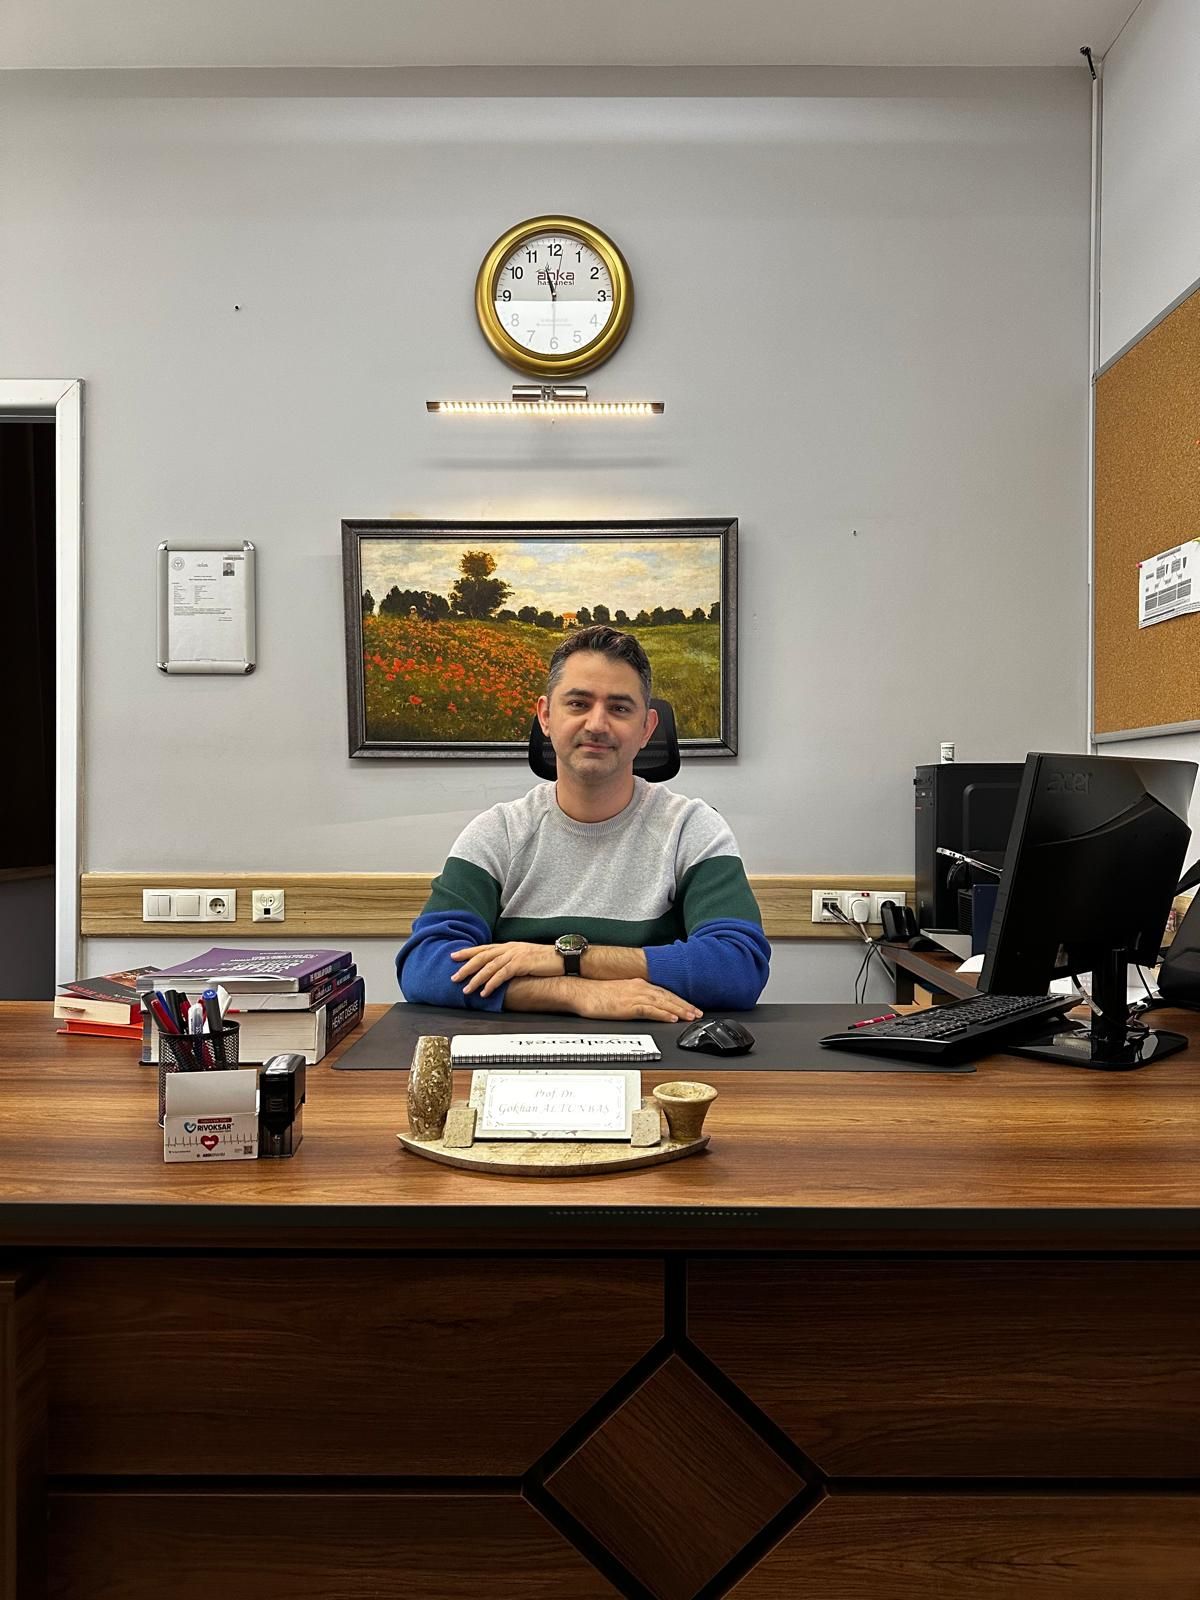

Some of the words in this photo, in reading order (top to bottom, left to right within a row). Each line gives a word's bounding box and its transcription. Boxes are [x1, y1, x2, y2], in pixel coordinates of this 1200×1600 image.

[526, 250, 538, 263] 11
[547, 244, 563, 257] 12
[575, 250, 582, 263] 1
[510, 266, 524, 280] 10
[537, 269, 576, 281] anka
[590, 266, 600, 280] 2
[502, 289, 512, 302] 9
[597, 289, 607, 302] 3
[510, 313, 520, 327] 8
[589, 314, 599, 327] 4
[527, 330, 536, 343] 7
[573, 330, 582, 344] 5
[549, 337, 559, 350] 6
[197, 1123, 232, 1132] RIVOKSAR
